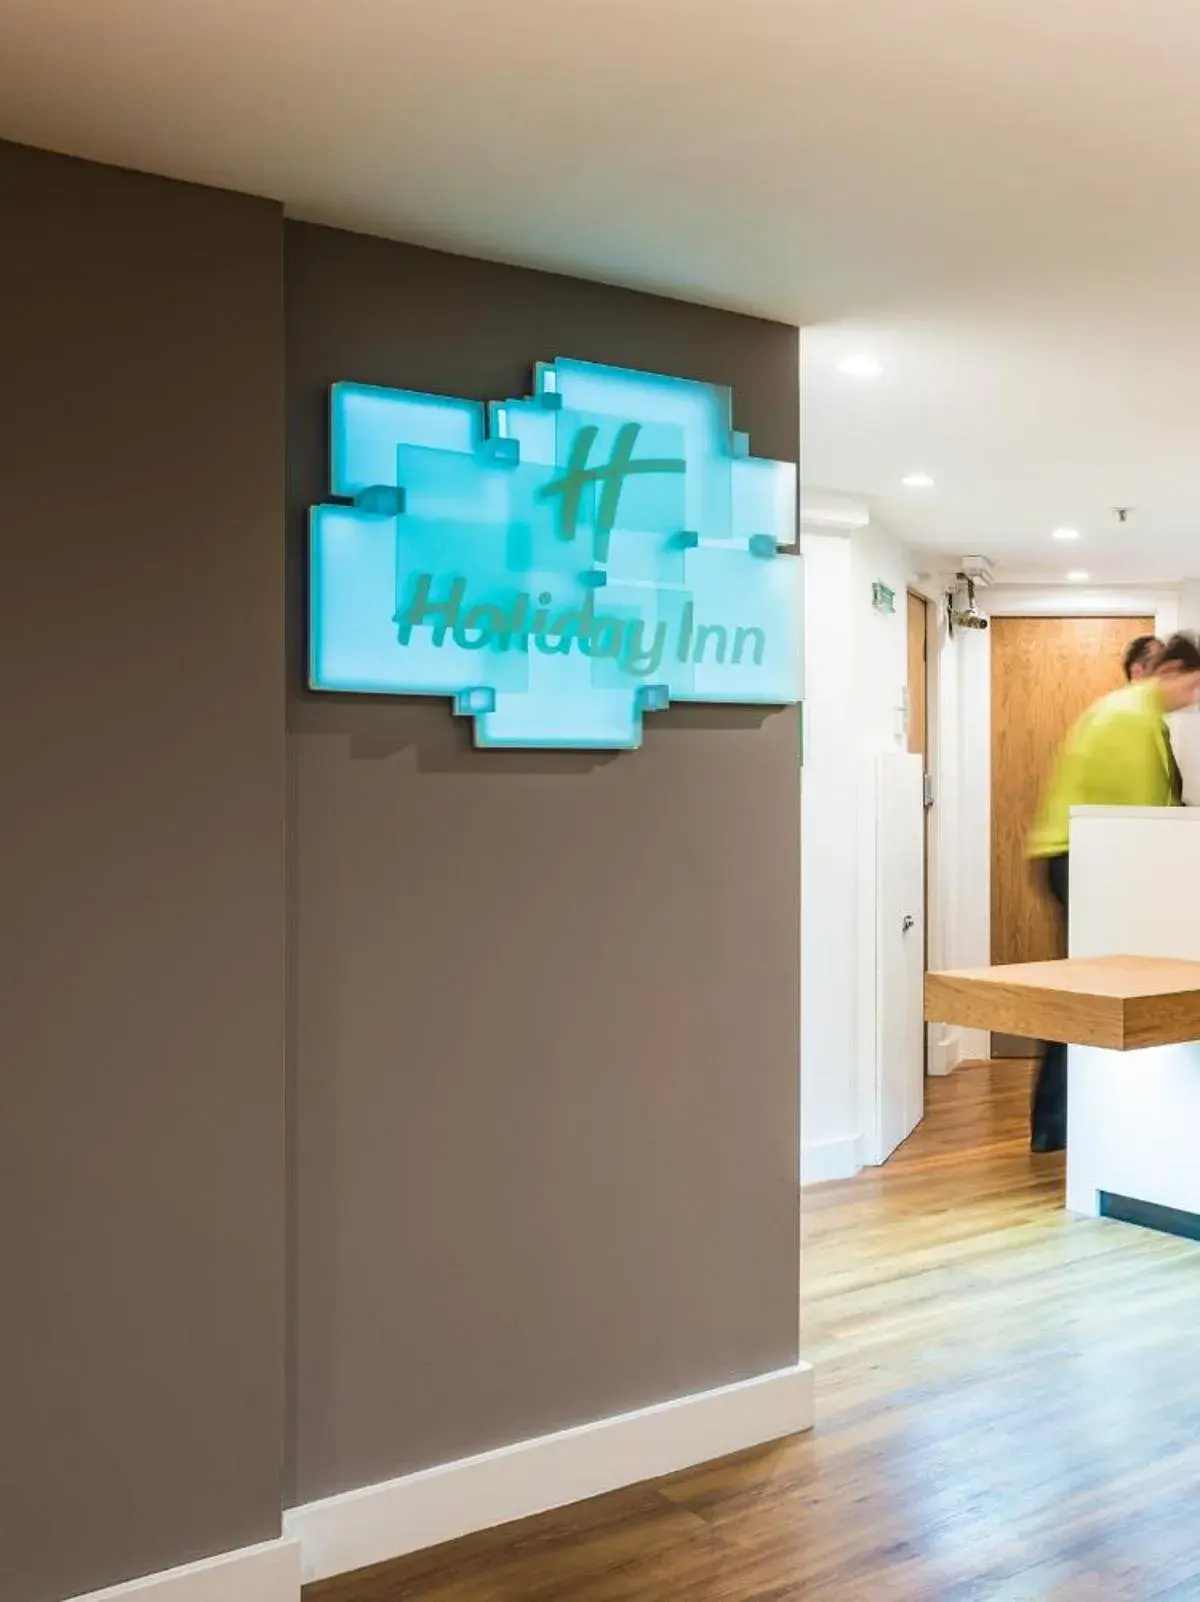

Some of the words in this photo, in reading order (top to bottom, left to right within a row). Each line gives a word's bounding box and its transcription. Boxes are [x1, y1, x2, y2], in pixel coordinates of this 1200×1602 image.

[540, 422, 686, 562] H
[393, 574, 665, 674] Holiday
[677, 601, 766, 665] Inn
